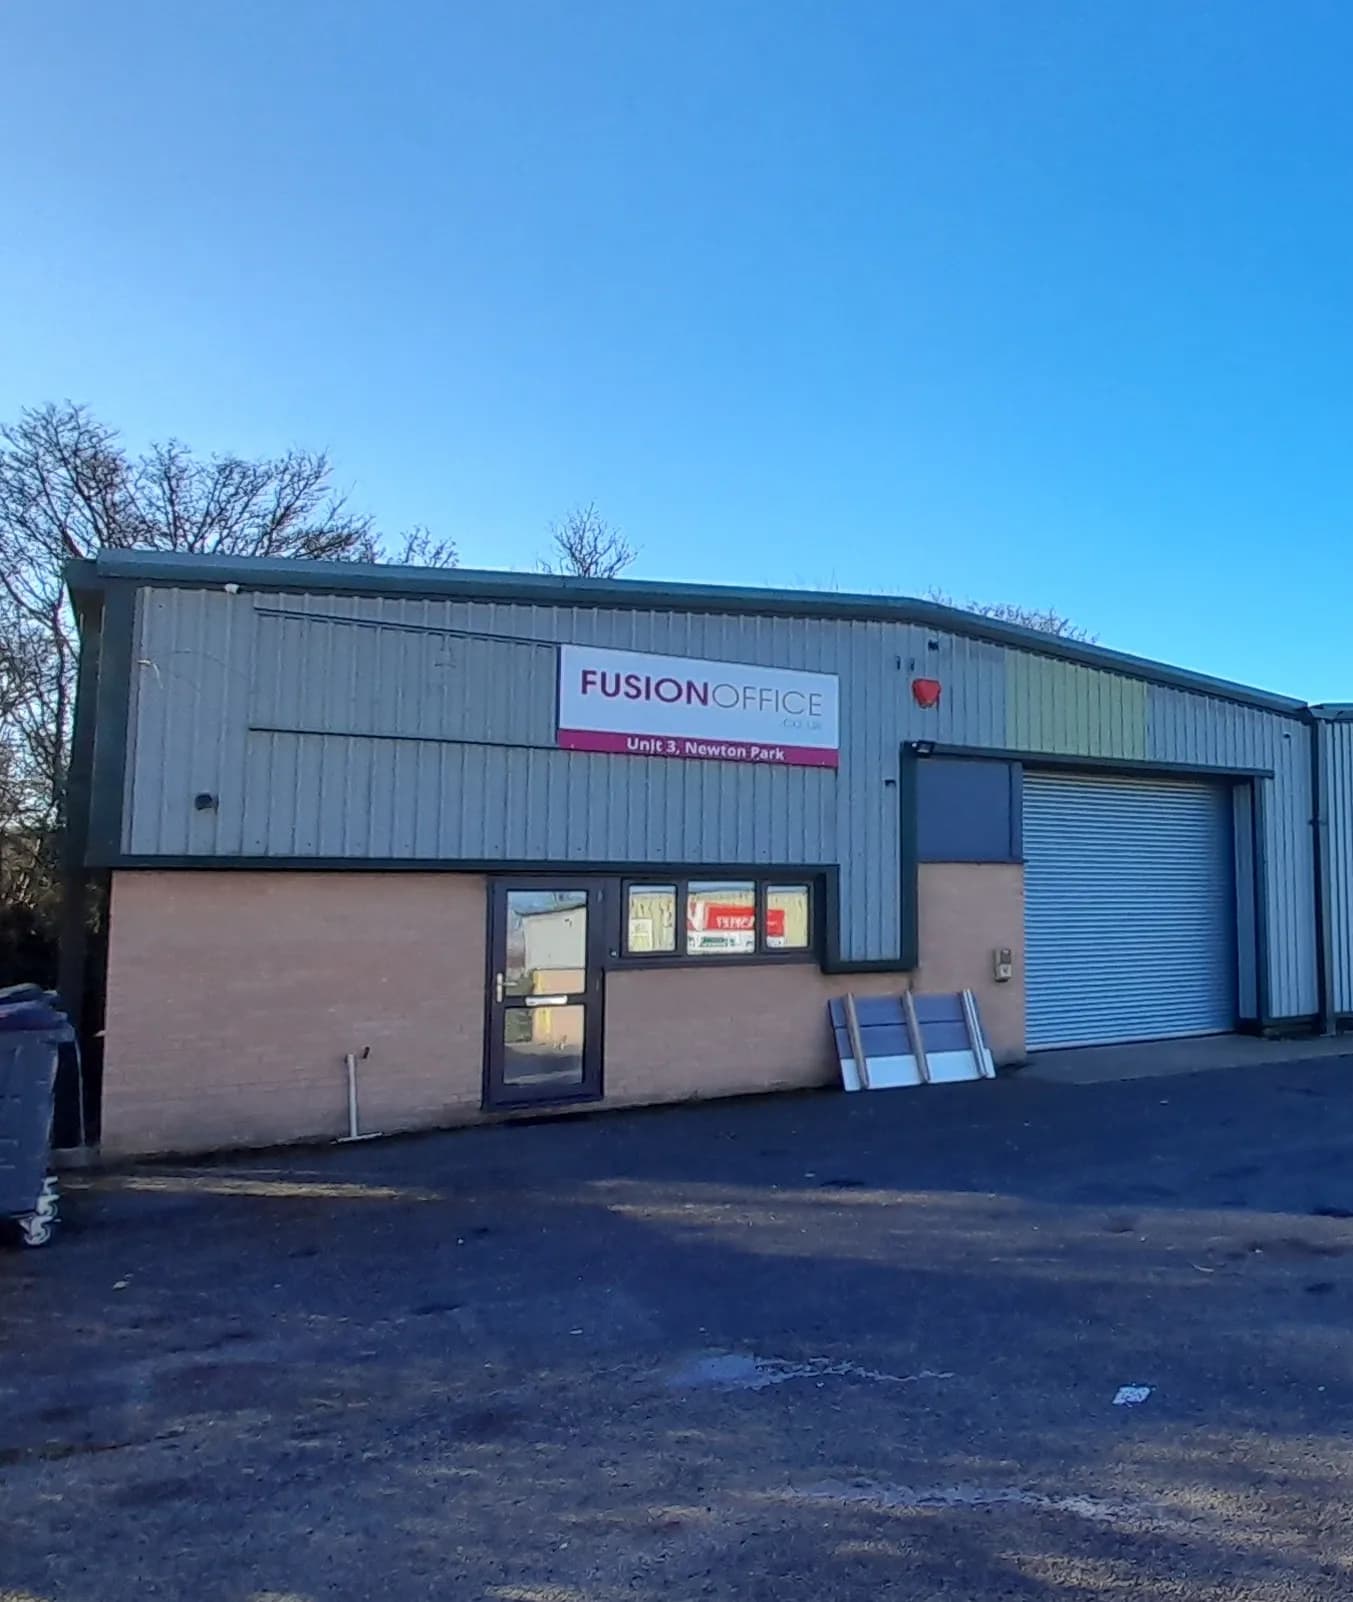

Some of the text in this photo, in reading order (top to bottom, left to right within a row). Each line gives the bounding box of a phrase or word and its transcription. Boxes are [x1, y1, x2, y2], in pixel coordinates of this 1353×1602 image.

[627, 736, 785, 761] Unit 3, Newton Park
